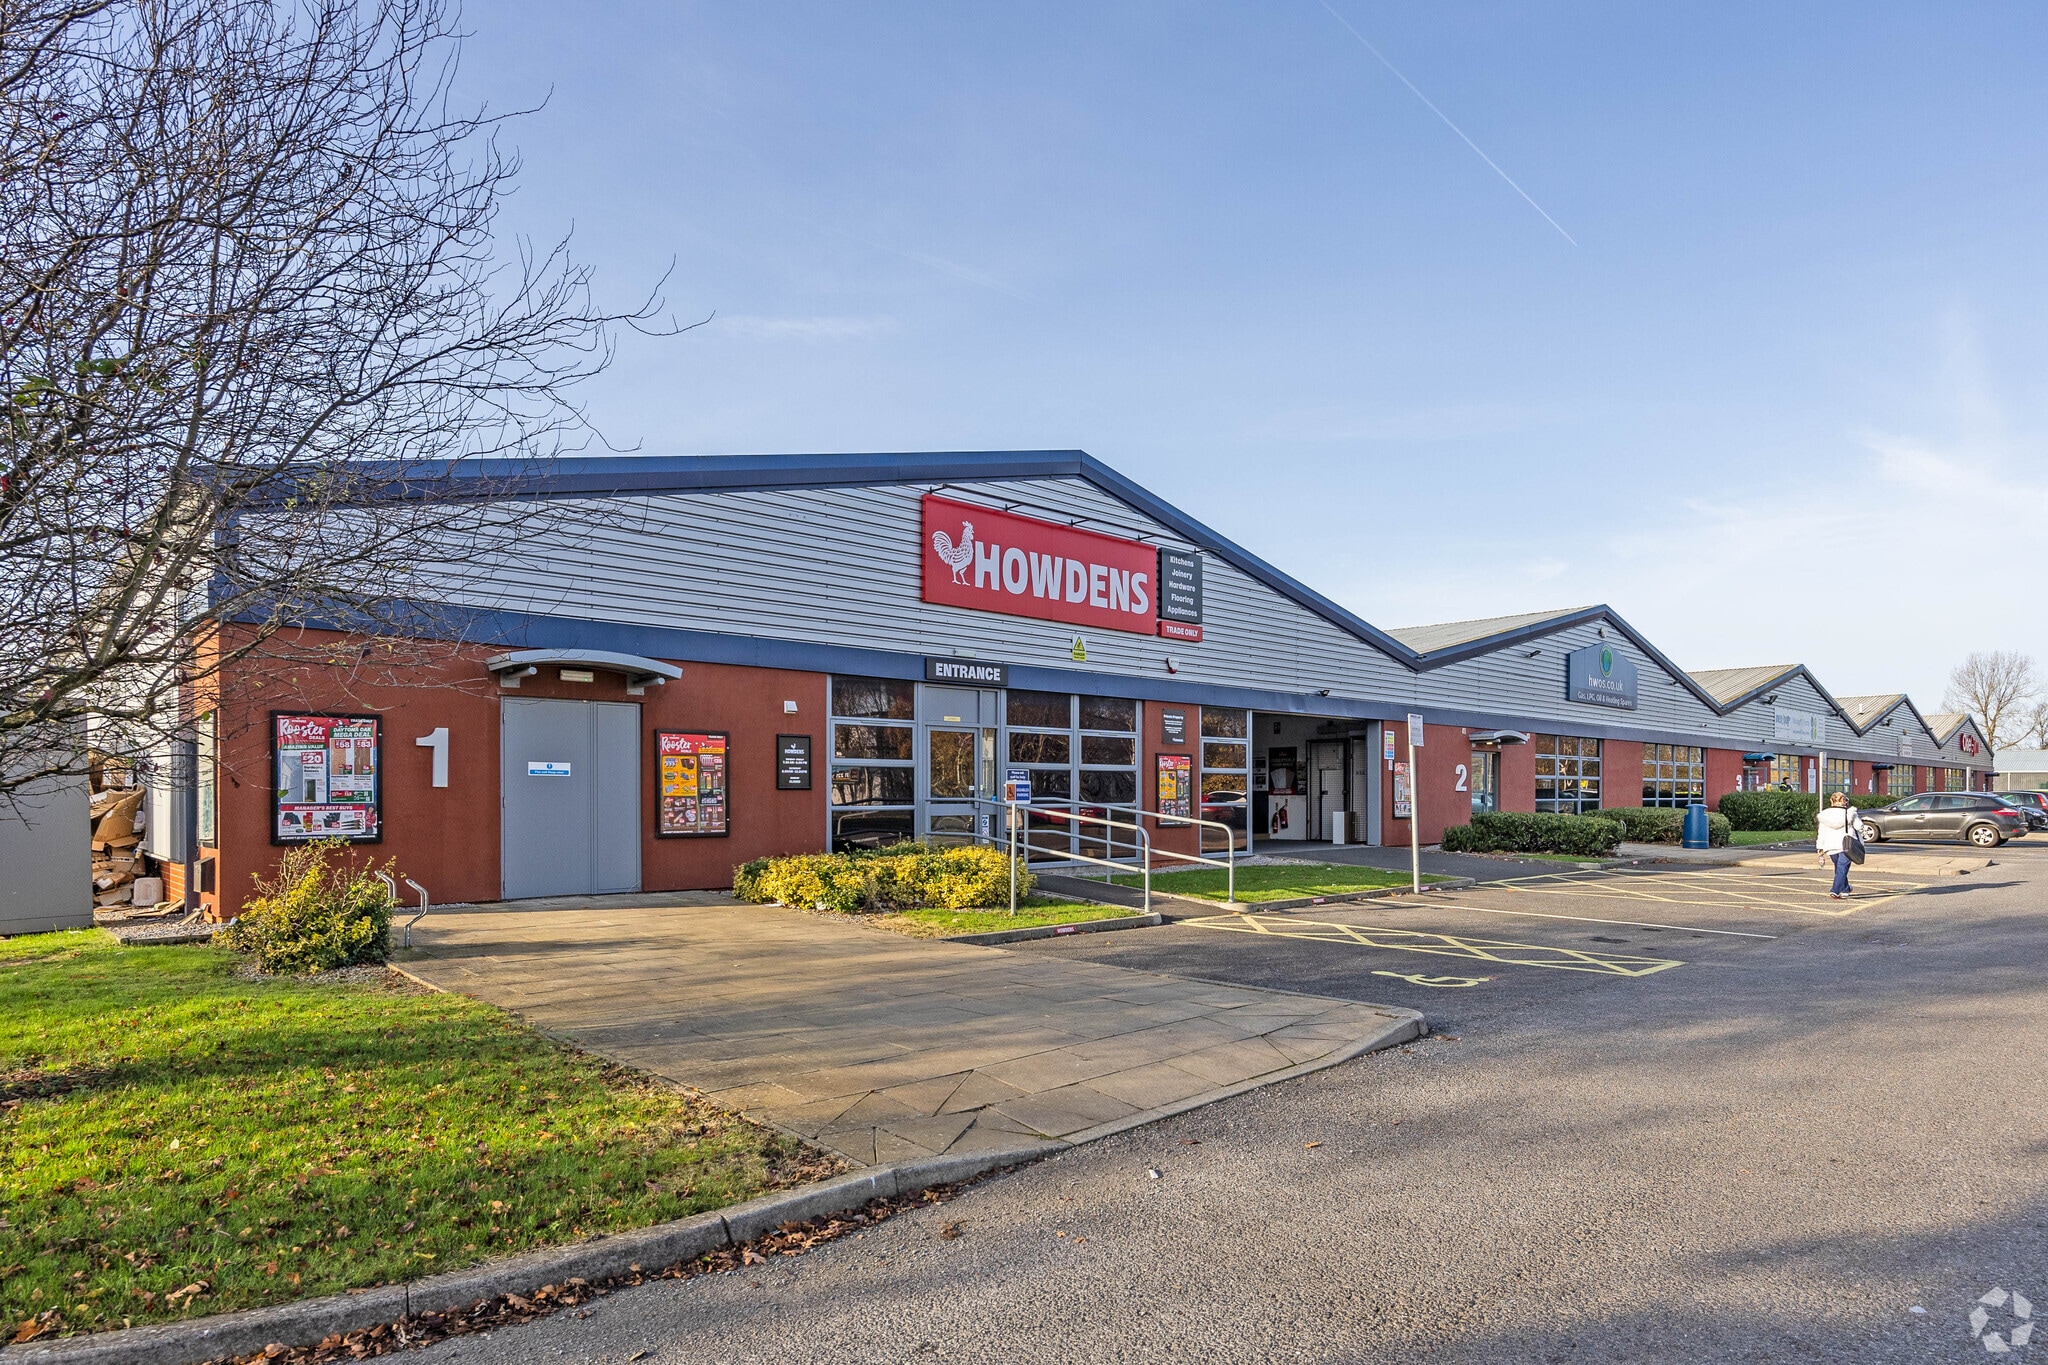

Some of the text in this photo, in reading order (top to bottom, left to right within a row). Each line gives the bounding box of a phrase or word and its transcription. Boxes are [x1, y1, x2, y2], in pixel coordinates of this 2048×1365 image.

[1169, 555, 1195, 568] Kitchens
[975, 541, 1149, 615] HOWDENS
[1171, 568, 1193, 581] Joinery
[1168, 580, 1196, 593] Hardware
[1170, 593, 1194, 606] Flooring
[1167, 605, 1198, 617] Appliances
[1166, 625, 1198, 638] TRADE ONLY
[935, 662, 1001, 682] ENTRANCE
[1588, 673, 1624, 692] hwos.co.uk
[1577, 691, 1586, 700] Gas,
[1586, 692, 1595, 701] LPG,
[1605, 695, 1620, 707] Heating
[1620, 697, 1633, 707] Spares
[279, 718, 326, 739] Rooster
[661, 736, 692, 752] Rooster
[302, 755, 322, 764] £20
[416, 727, 449, 788] 1
[1455, 764, 1467, 791] 2
[1735, 774, 1743, 792] 3
